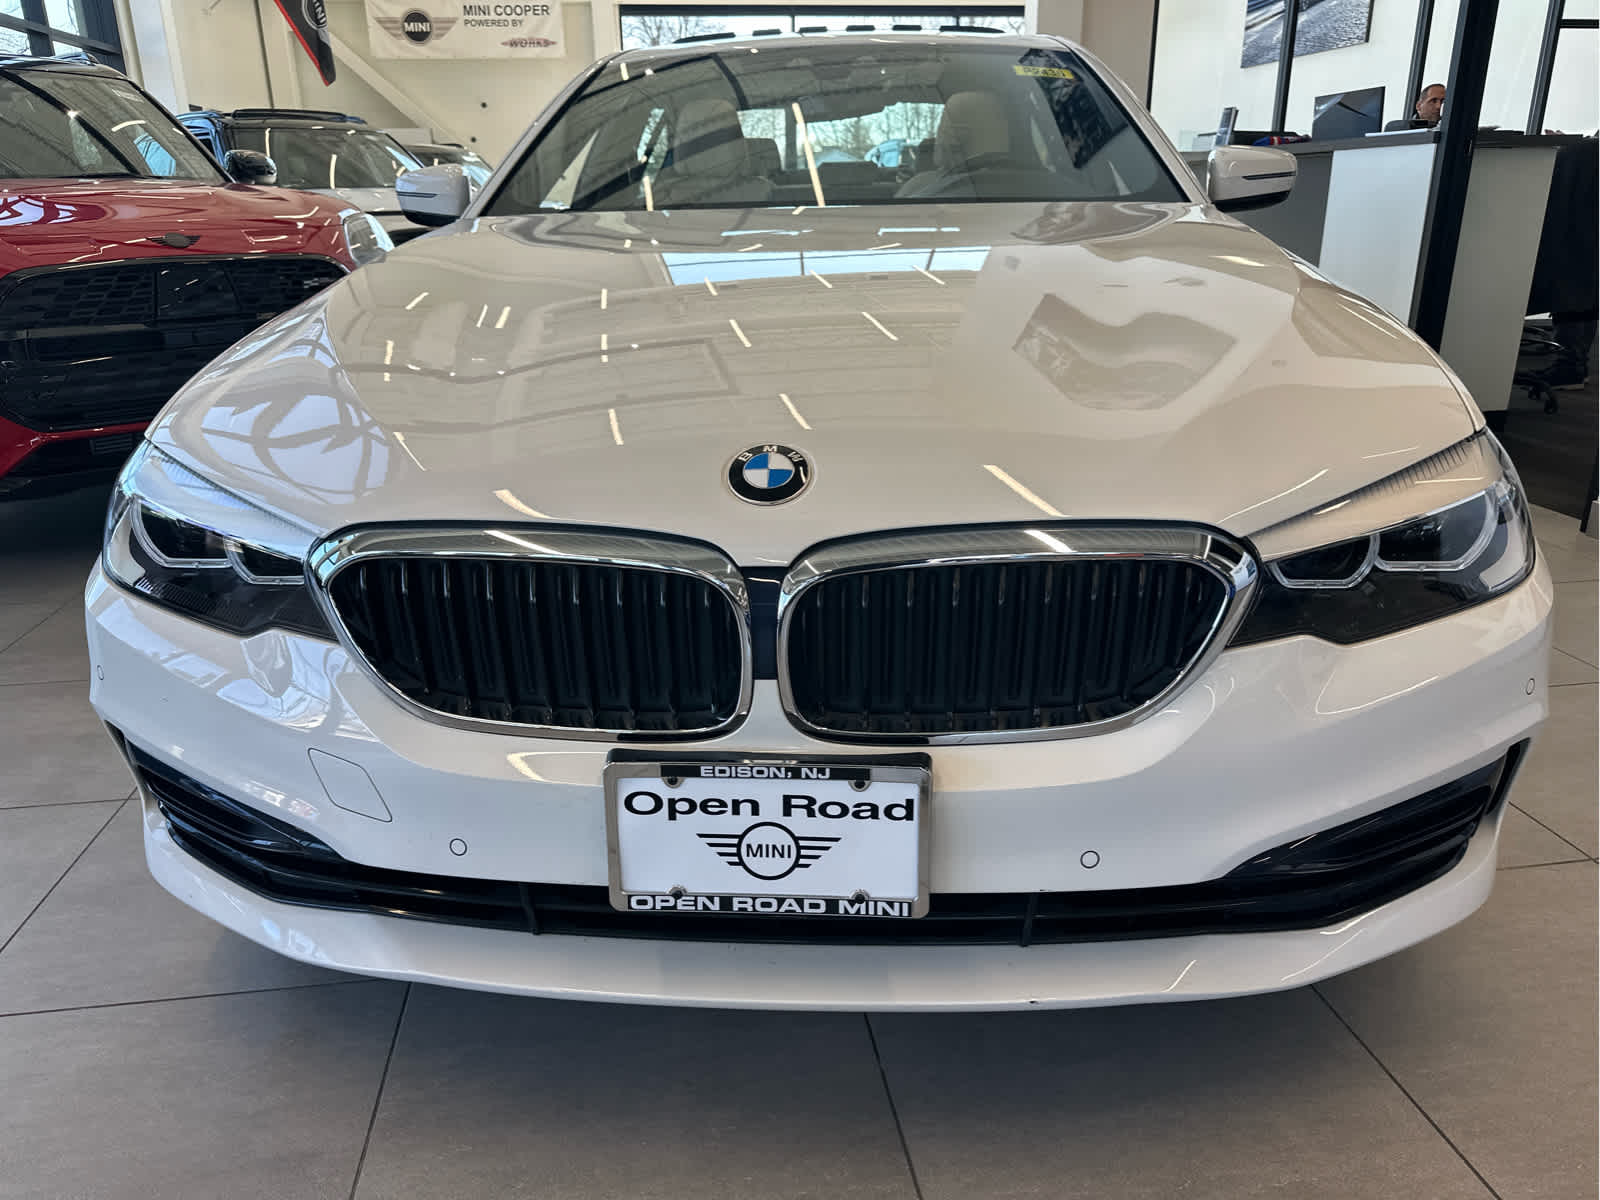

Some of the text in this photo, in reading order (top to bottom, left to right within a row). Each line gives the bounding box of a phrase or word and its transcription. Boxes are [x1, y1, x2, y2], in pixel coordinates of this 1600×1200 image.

[312, 0, 327, 23] INI
[464, 5, 550, 16] MINI COOPER
[404, 22, 431, 33] MINI
[464, 19, 523, 28] POWERED BY
[738, 445, 803, 462] BMW
[700, 765, 831, 780] EDISON, NJ
[623, 791, 915, 822] Open Road
[746, 843, 792, 859] MINI
[630, 895, 910, 917] OPEN ROAD MINI
